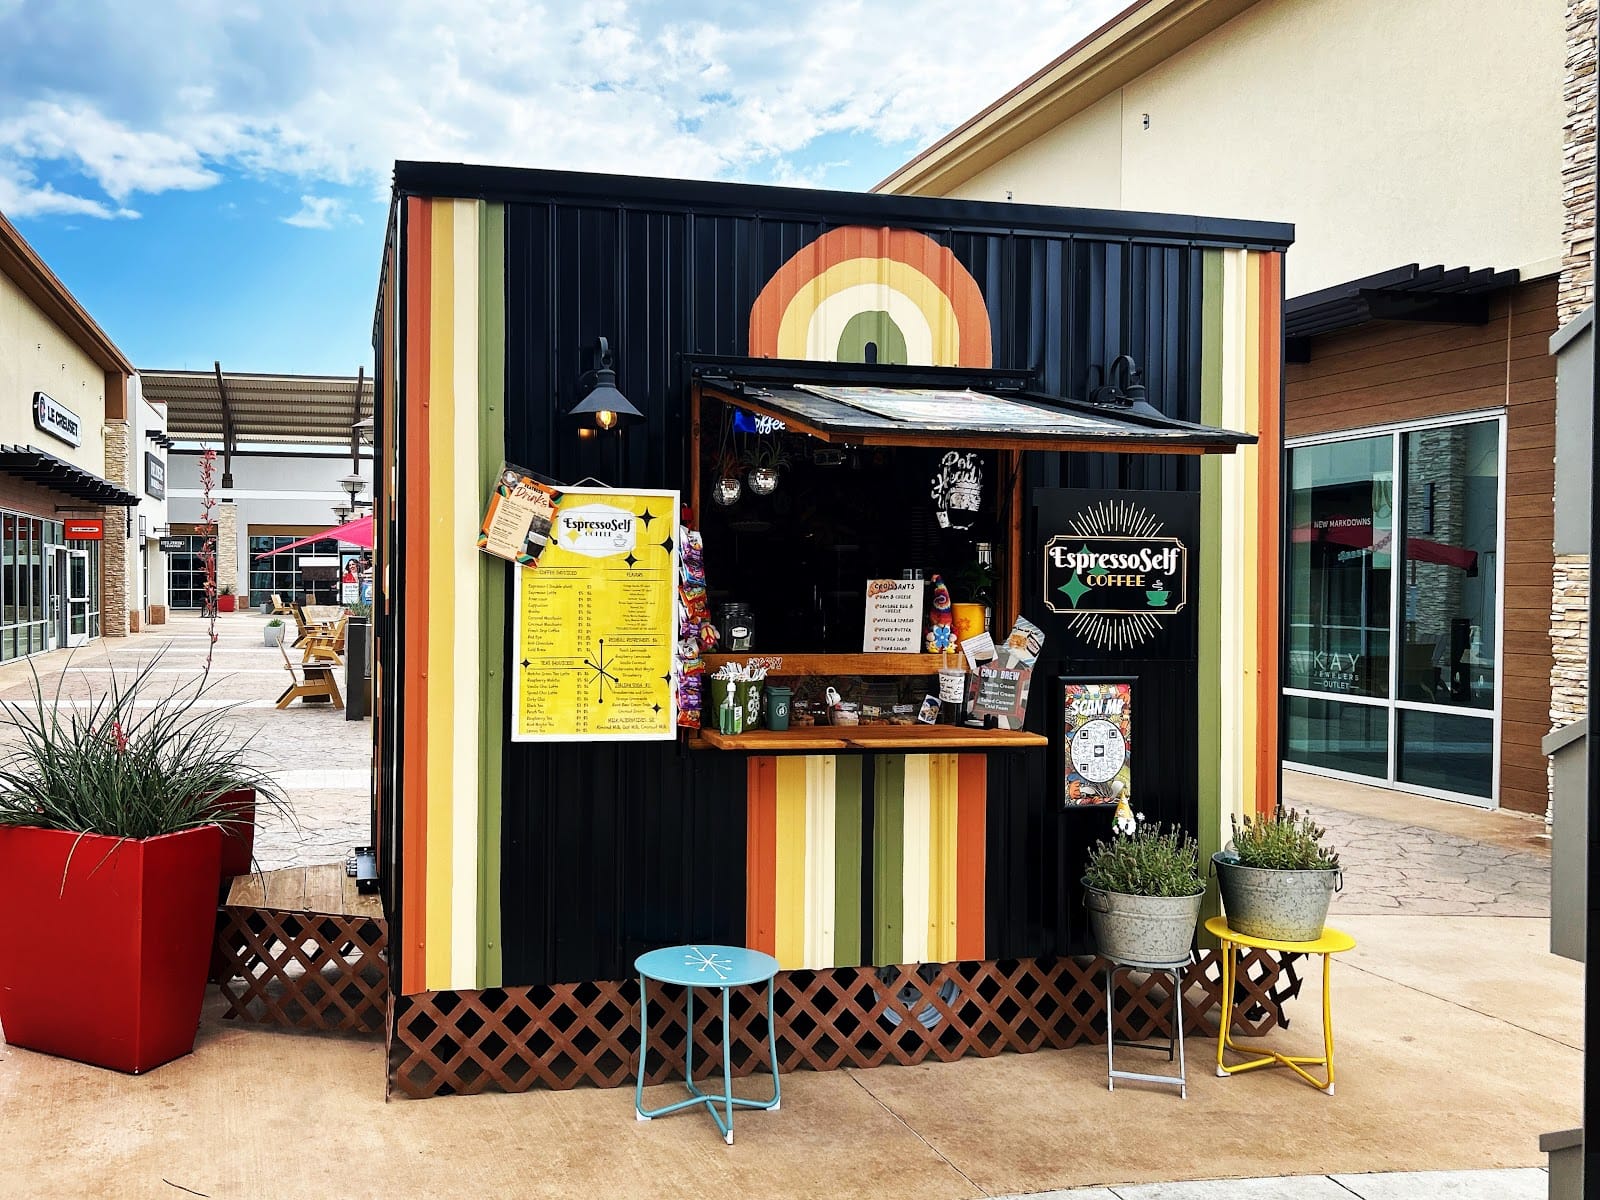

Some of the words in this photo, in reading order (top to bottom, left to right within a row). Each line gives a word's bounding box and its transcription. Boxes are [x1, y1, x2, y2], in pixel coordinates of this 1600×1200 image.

[48, 406, 55, 424] LE
[56, 411, 78, 437] CREUSET
[754, 413, 786, 434] offee
[514, 486, 548, 508] Drinks
[563, 518, 634, 532] EspressoSelf
[1330, 518, 1371, 528] MARKDOWNS
[1049, 546, 1181, 576] EspressoSelf
[1086, 574, 1146, 587] COFFEE
[1313, 650, 1360, 672] KAY
[981, 669, 998, 678] COLD
[1000, 670, 1020, 680] BREW
[1314, 671, 1359, 681] JEWELERS
[1071, 699, 1102, 716] SCAN
[1105, 699, 1125, 715] ME
